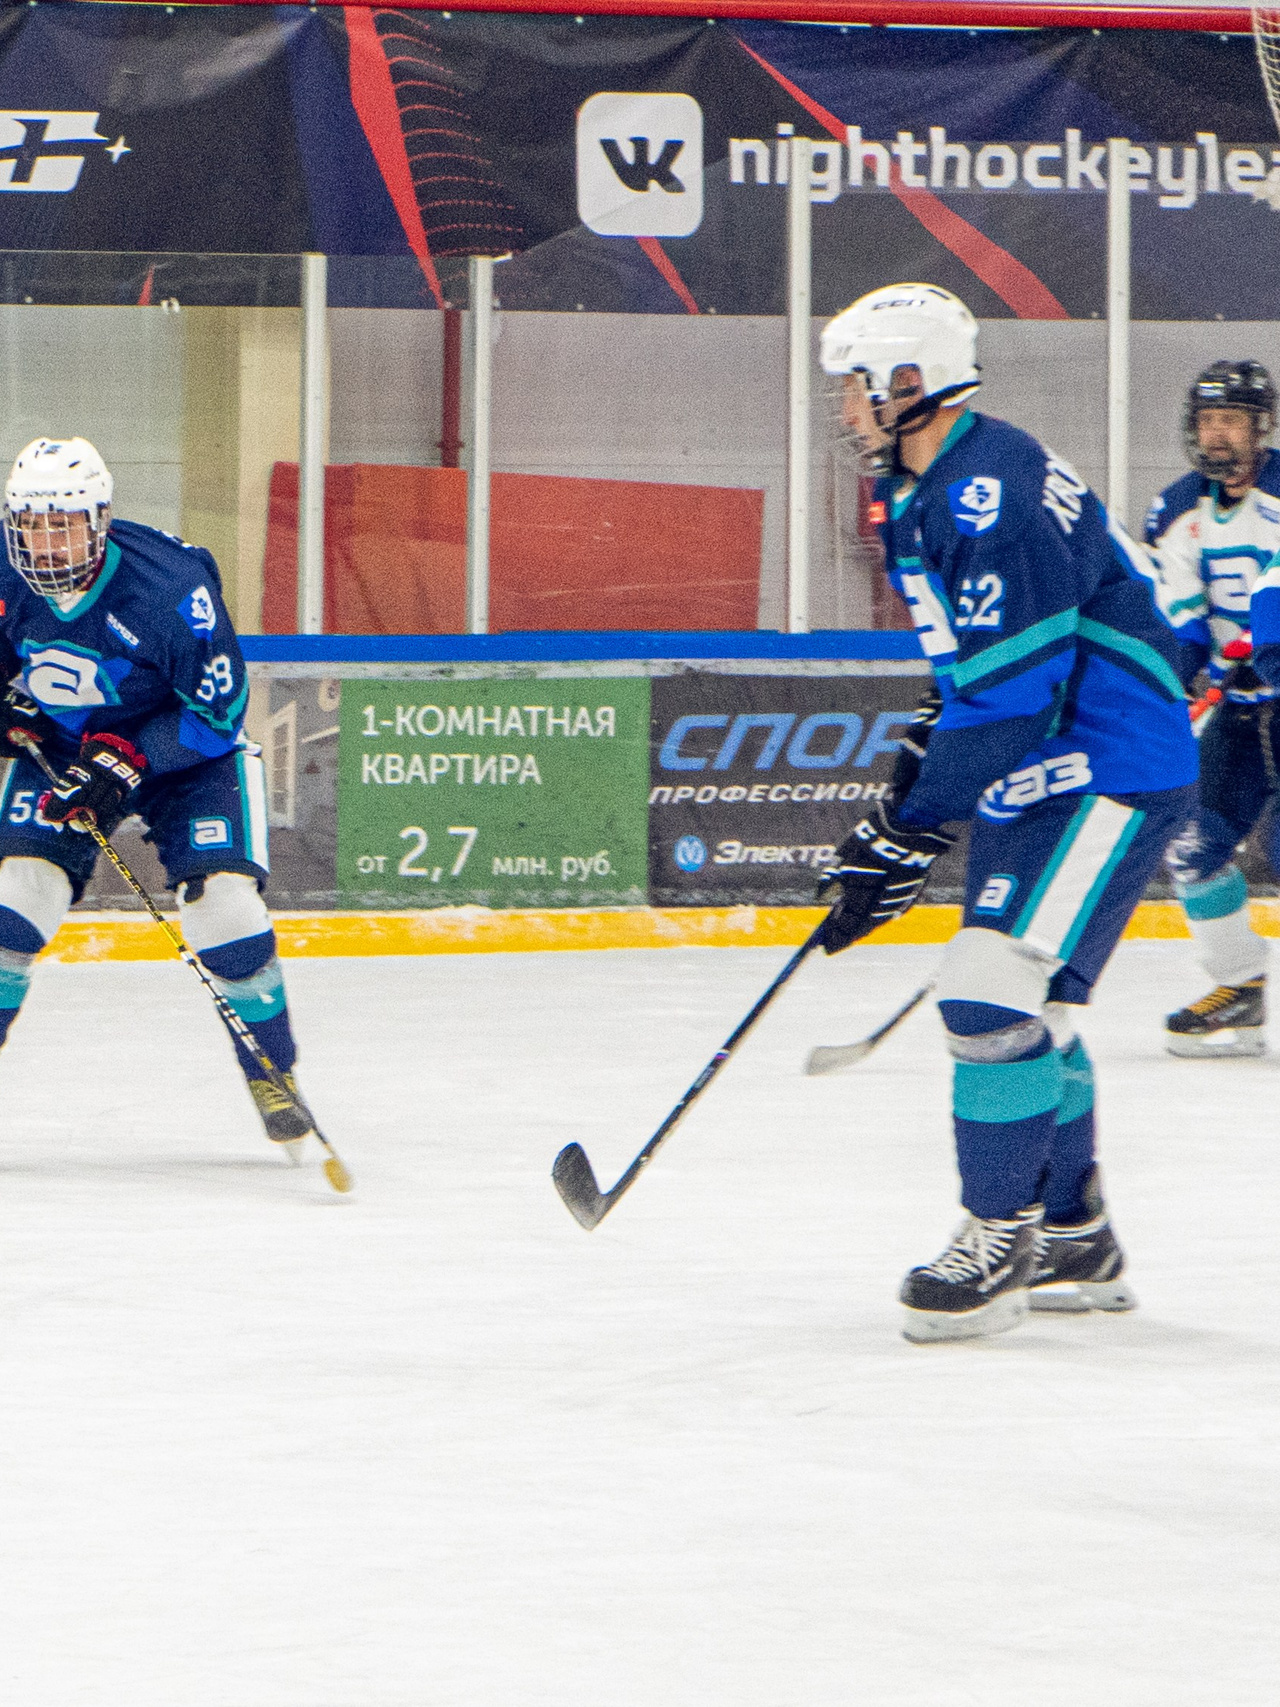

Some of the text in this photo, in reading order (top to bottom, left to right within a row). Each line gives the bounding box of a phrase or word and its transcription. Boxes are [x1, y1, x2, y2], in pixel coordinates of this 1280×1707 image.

[361, 704, 617, 738] 1-КОМНАТНАЯ
[360, 753, 543, 786] КВАРТИРА
[648, 782, 895, 805] ПРОФЕССИОН
[356, 825, 618, 883] от 2,7 млн. руб.
[713, 839, 842, 868] Электр
[852, 818, 938, 869] CCM
